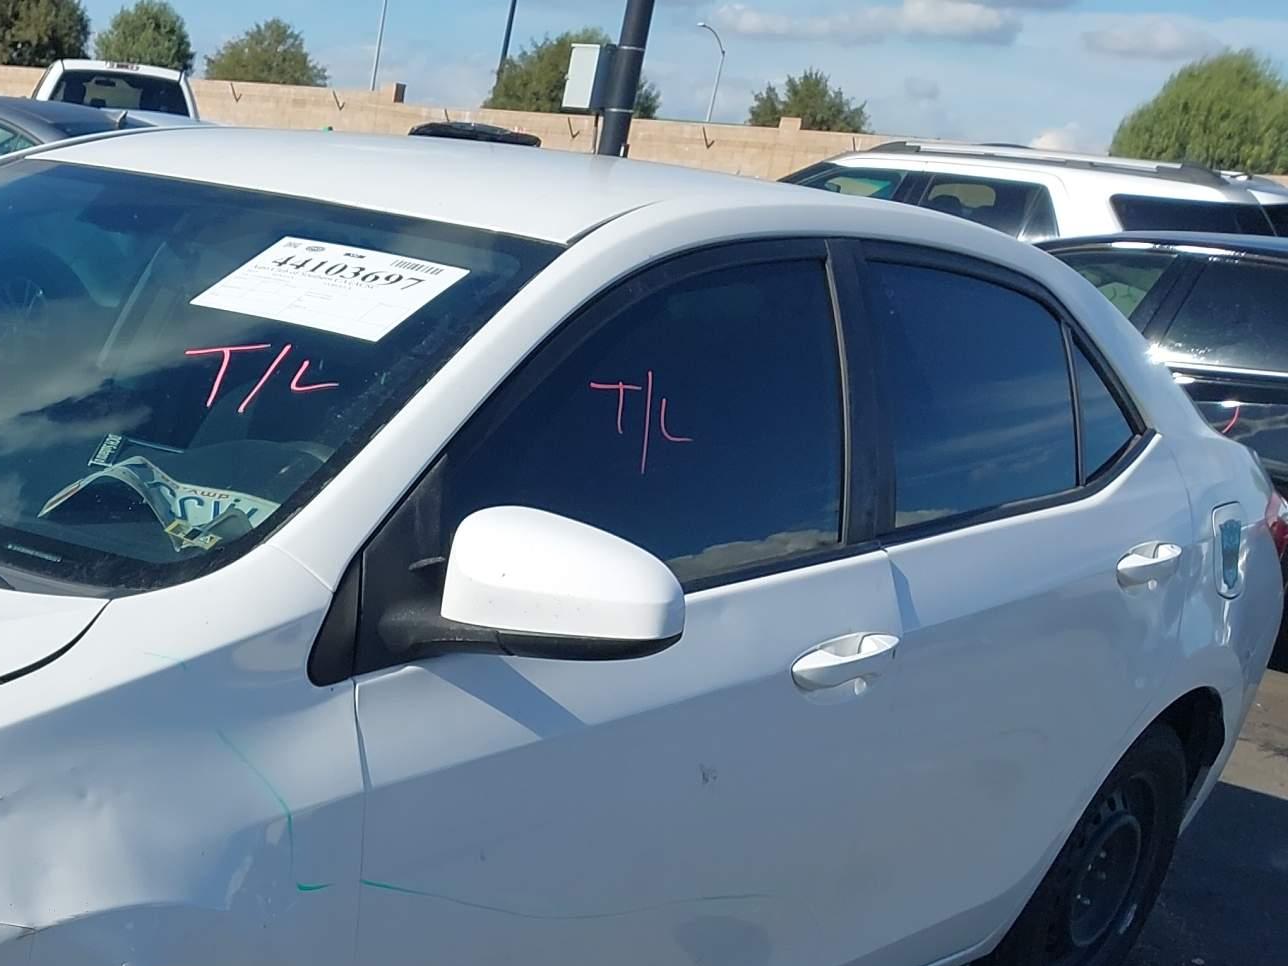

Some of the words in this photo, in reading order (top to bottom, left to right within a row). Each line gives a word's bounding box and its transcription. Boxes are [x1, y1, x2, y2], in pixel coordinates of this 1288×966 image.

[272, 254, 426, 291] 44103697
[184, 343, 340, 413] T/L
[590, 370, 694, 475] T/L
